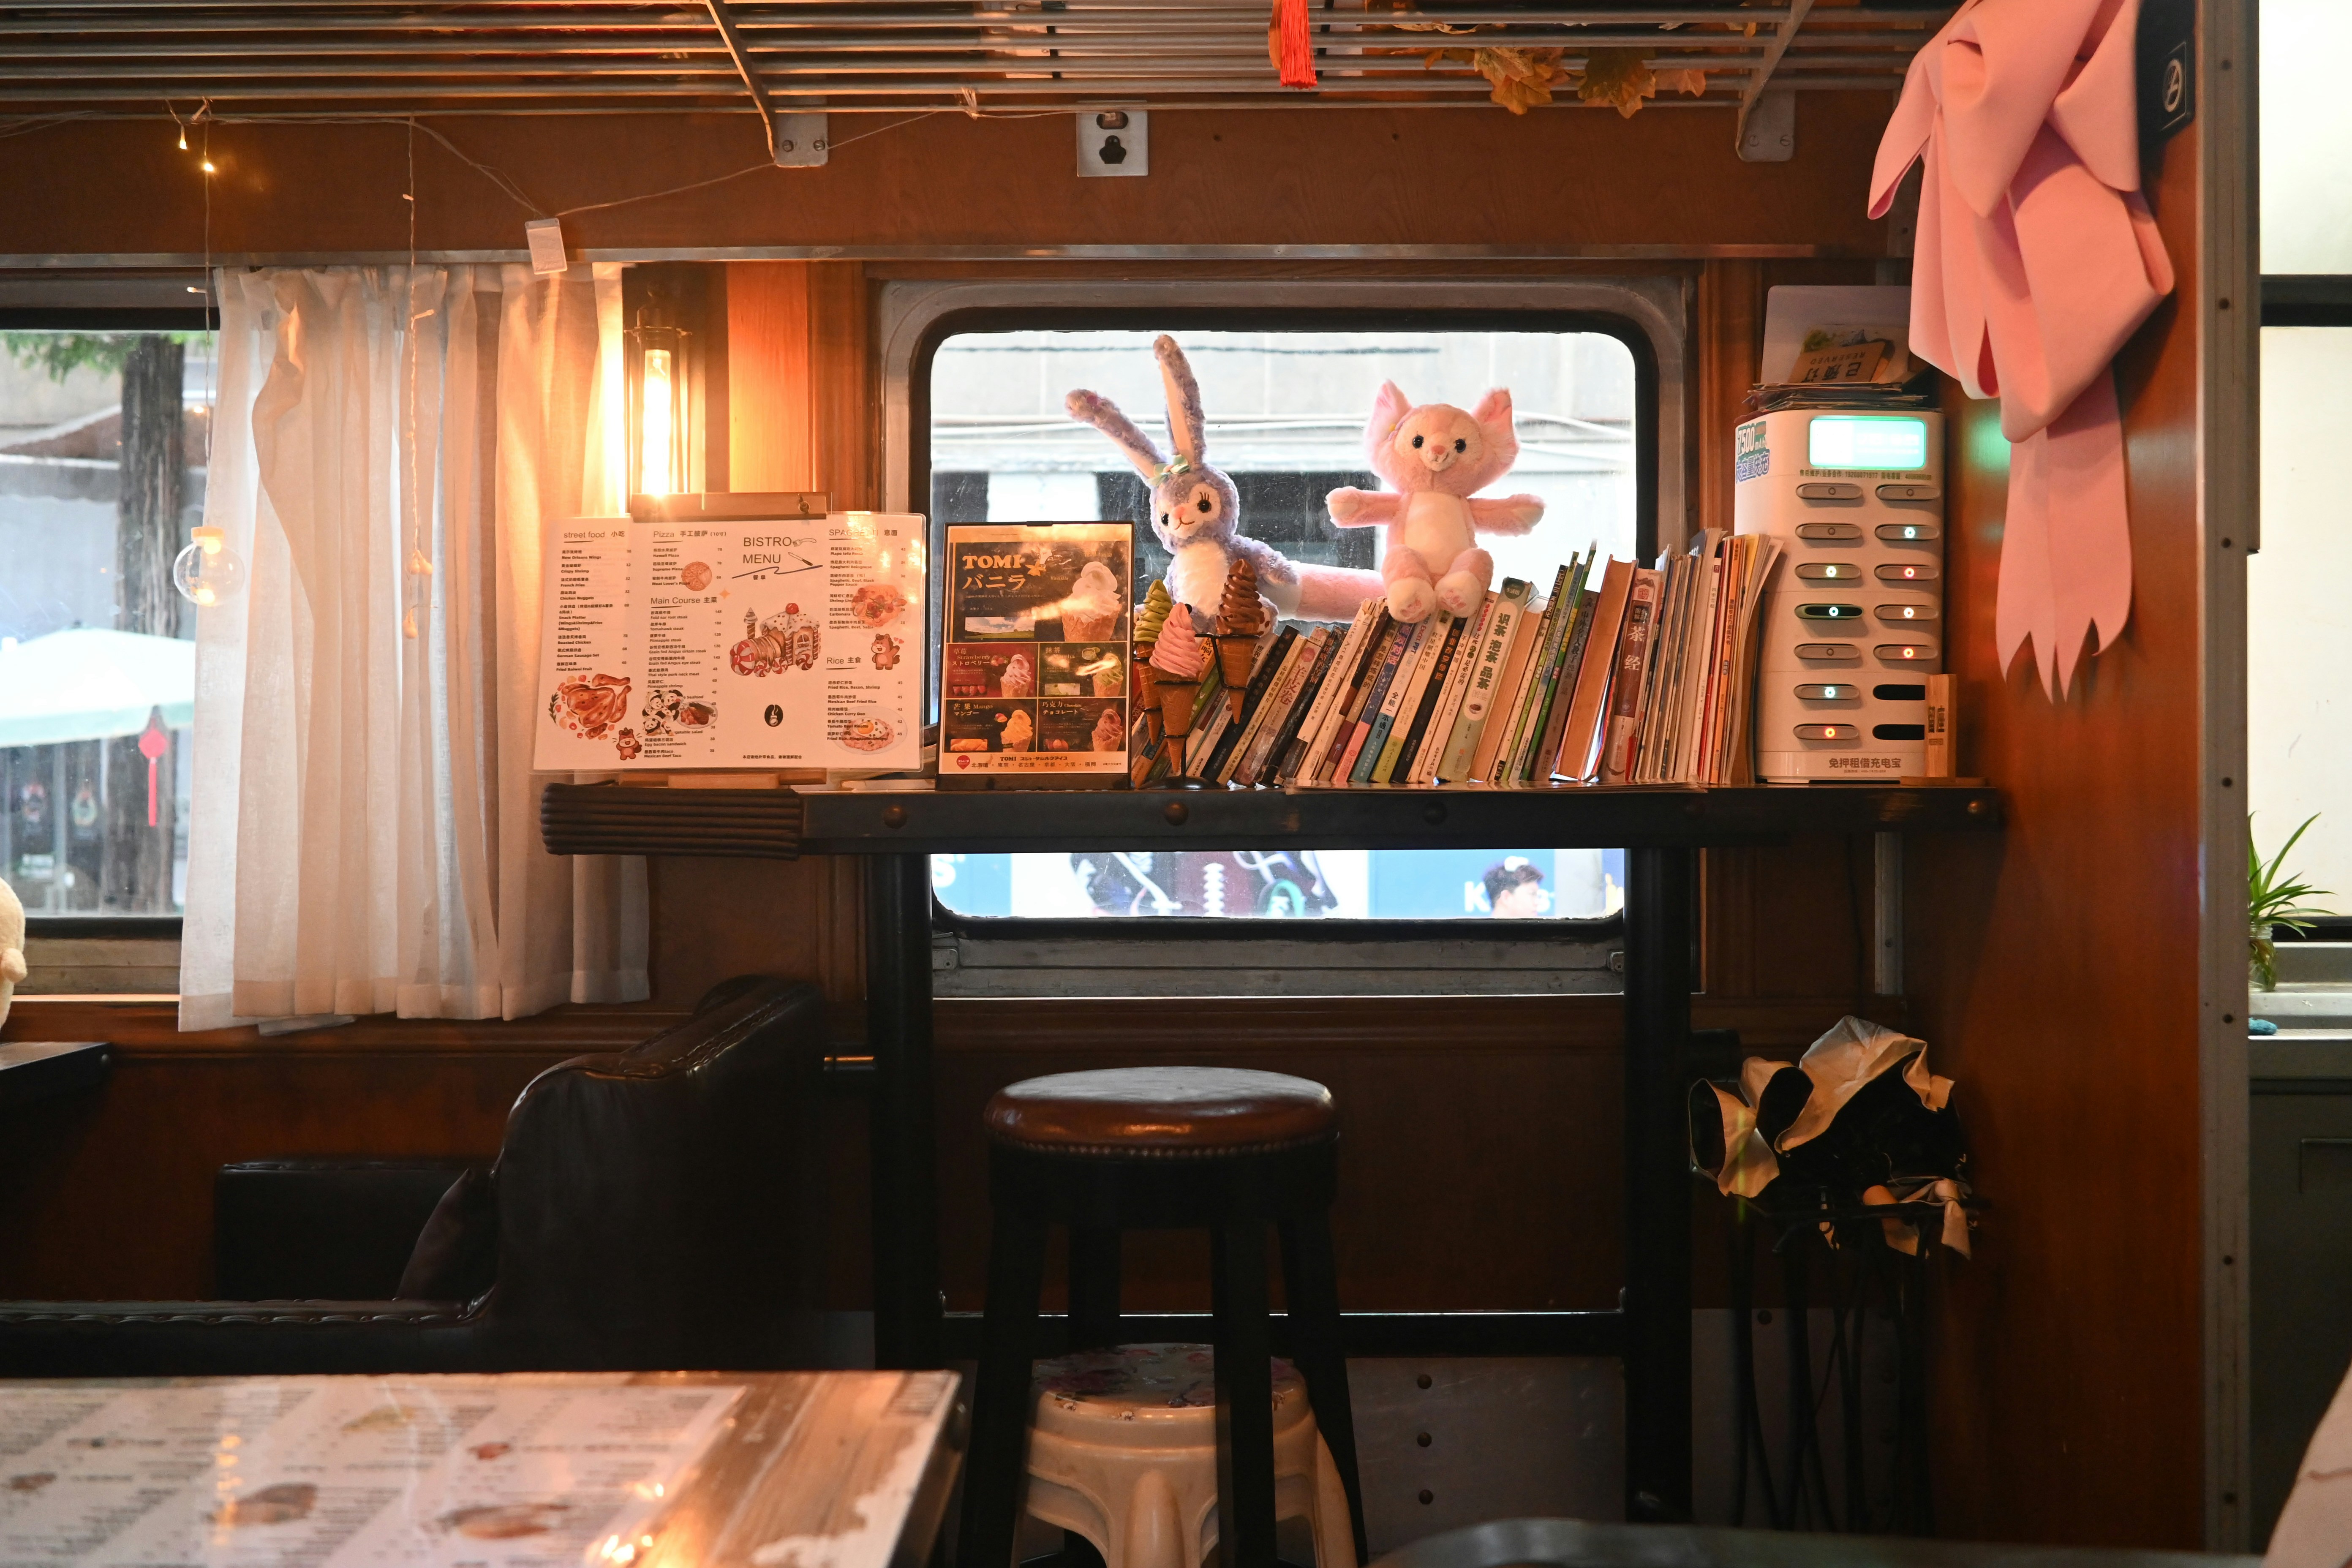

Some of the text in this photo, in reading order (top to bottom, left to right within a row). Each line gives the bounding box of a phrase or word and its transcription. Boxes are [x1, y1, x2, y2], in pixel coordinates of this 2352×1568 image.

[1810, 351, 1866, 365] RESERVED
[1801, 362, 1862, 383] 已预订
[1738, 426, 1766, 455] 7500 mAh
[1736, 451, 1769, 482] 大容量快充
[743, 537, 792, 547] BISTRO
[743, 554, 781, 564] MENU
[962, 555, 1022, 569] TOMI
[962, 574, 1026, 590] バニラ
[1342, 619, 1360, 653] Latte Art
[1493, 613, 1511, 637] 识茶
[1411, 625, 1427, 655] EXCEL PPT
[1419, 632, 1437, 671] 红星照耀中国
[1453, 635, 1467, 663] 手冲咖啡
[1485, 640, 1502, 664] 泡茶
[1624, 626, 1645, 671] 茶经
[1457, 633, 1481, 685] 这些习惯是必需的
[1279, 664, 1307, 705] 羊皮卷
[1476, 666, 1494, 690] 品茶
[1829, 758, 1901, 768] 免押租借充电宝
